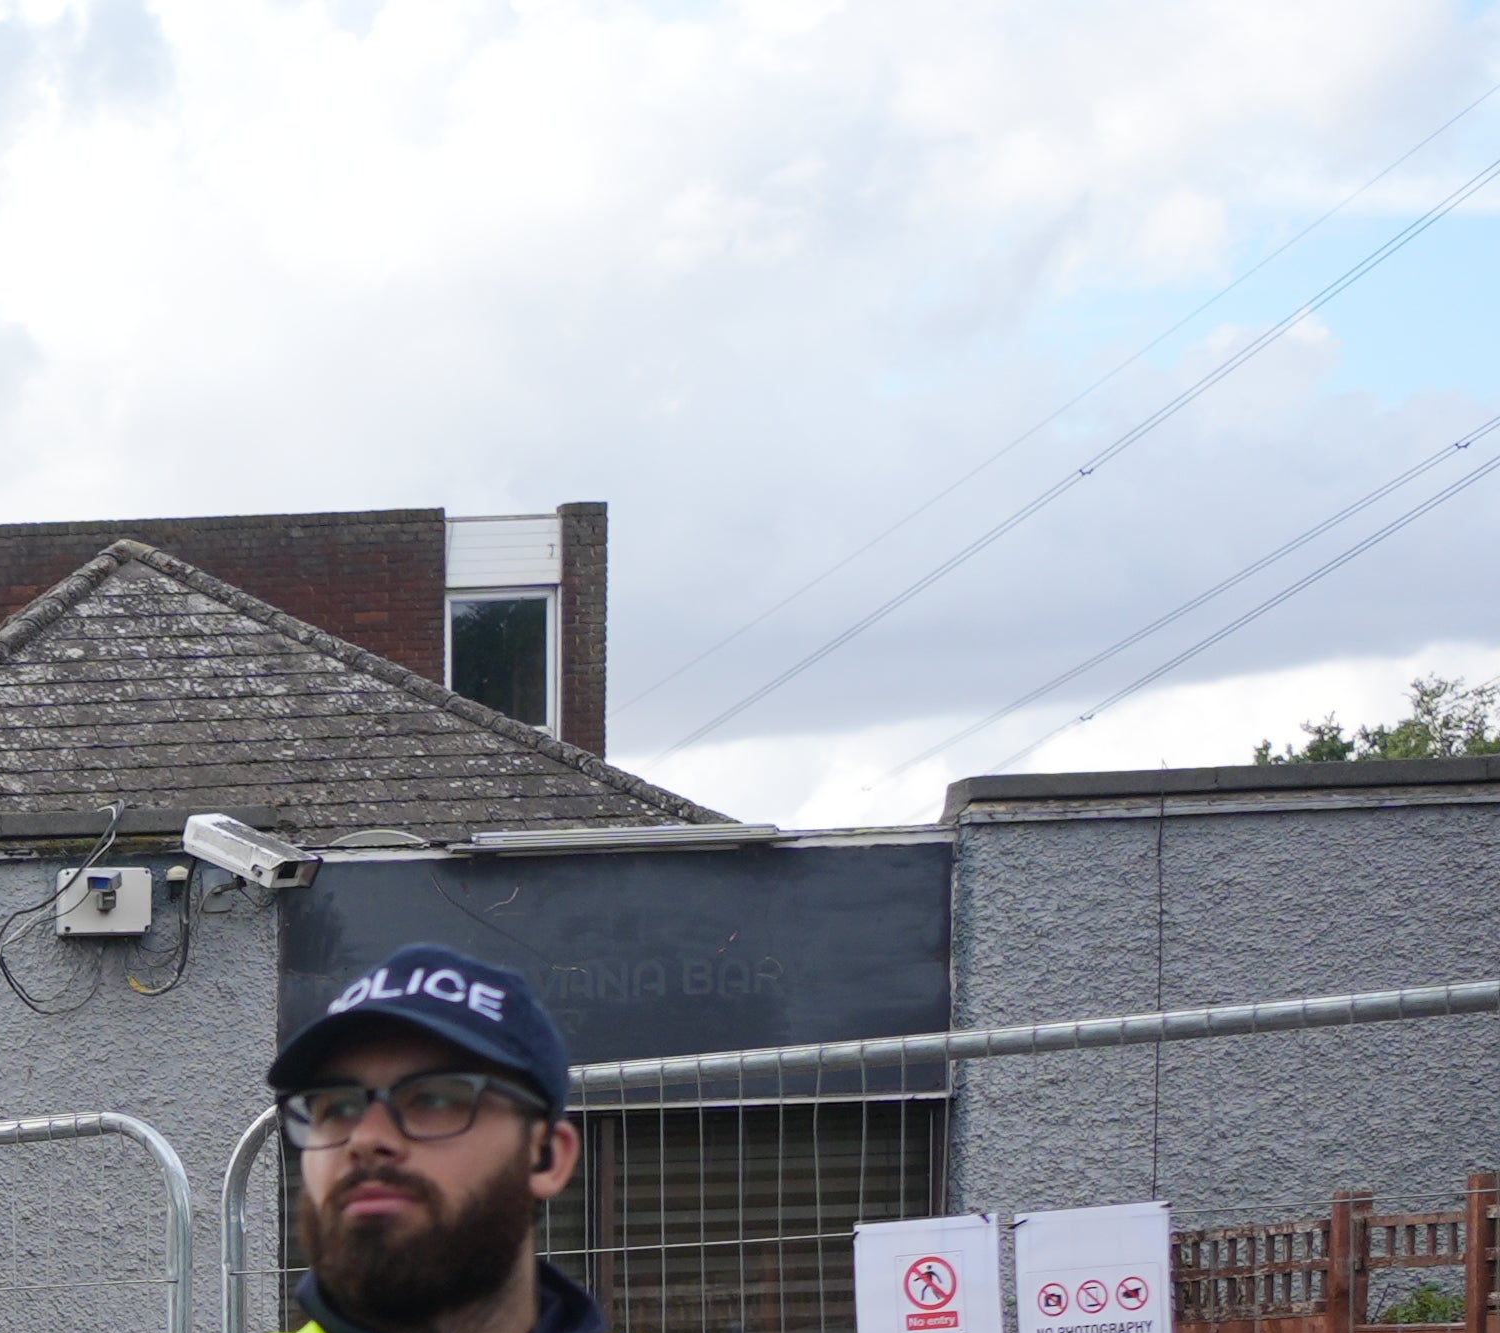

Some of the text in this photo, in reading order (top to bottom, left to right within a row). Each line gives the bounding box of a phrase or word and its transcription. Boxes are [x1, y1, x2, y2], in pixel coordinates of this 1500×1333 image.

[327, 966, 508, 1022] OLICE
[908, 1316, 956, 1327] No entry
